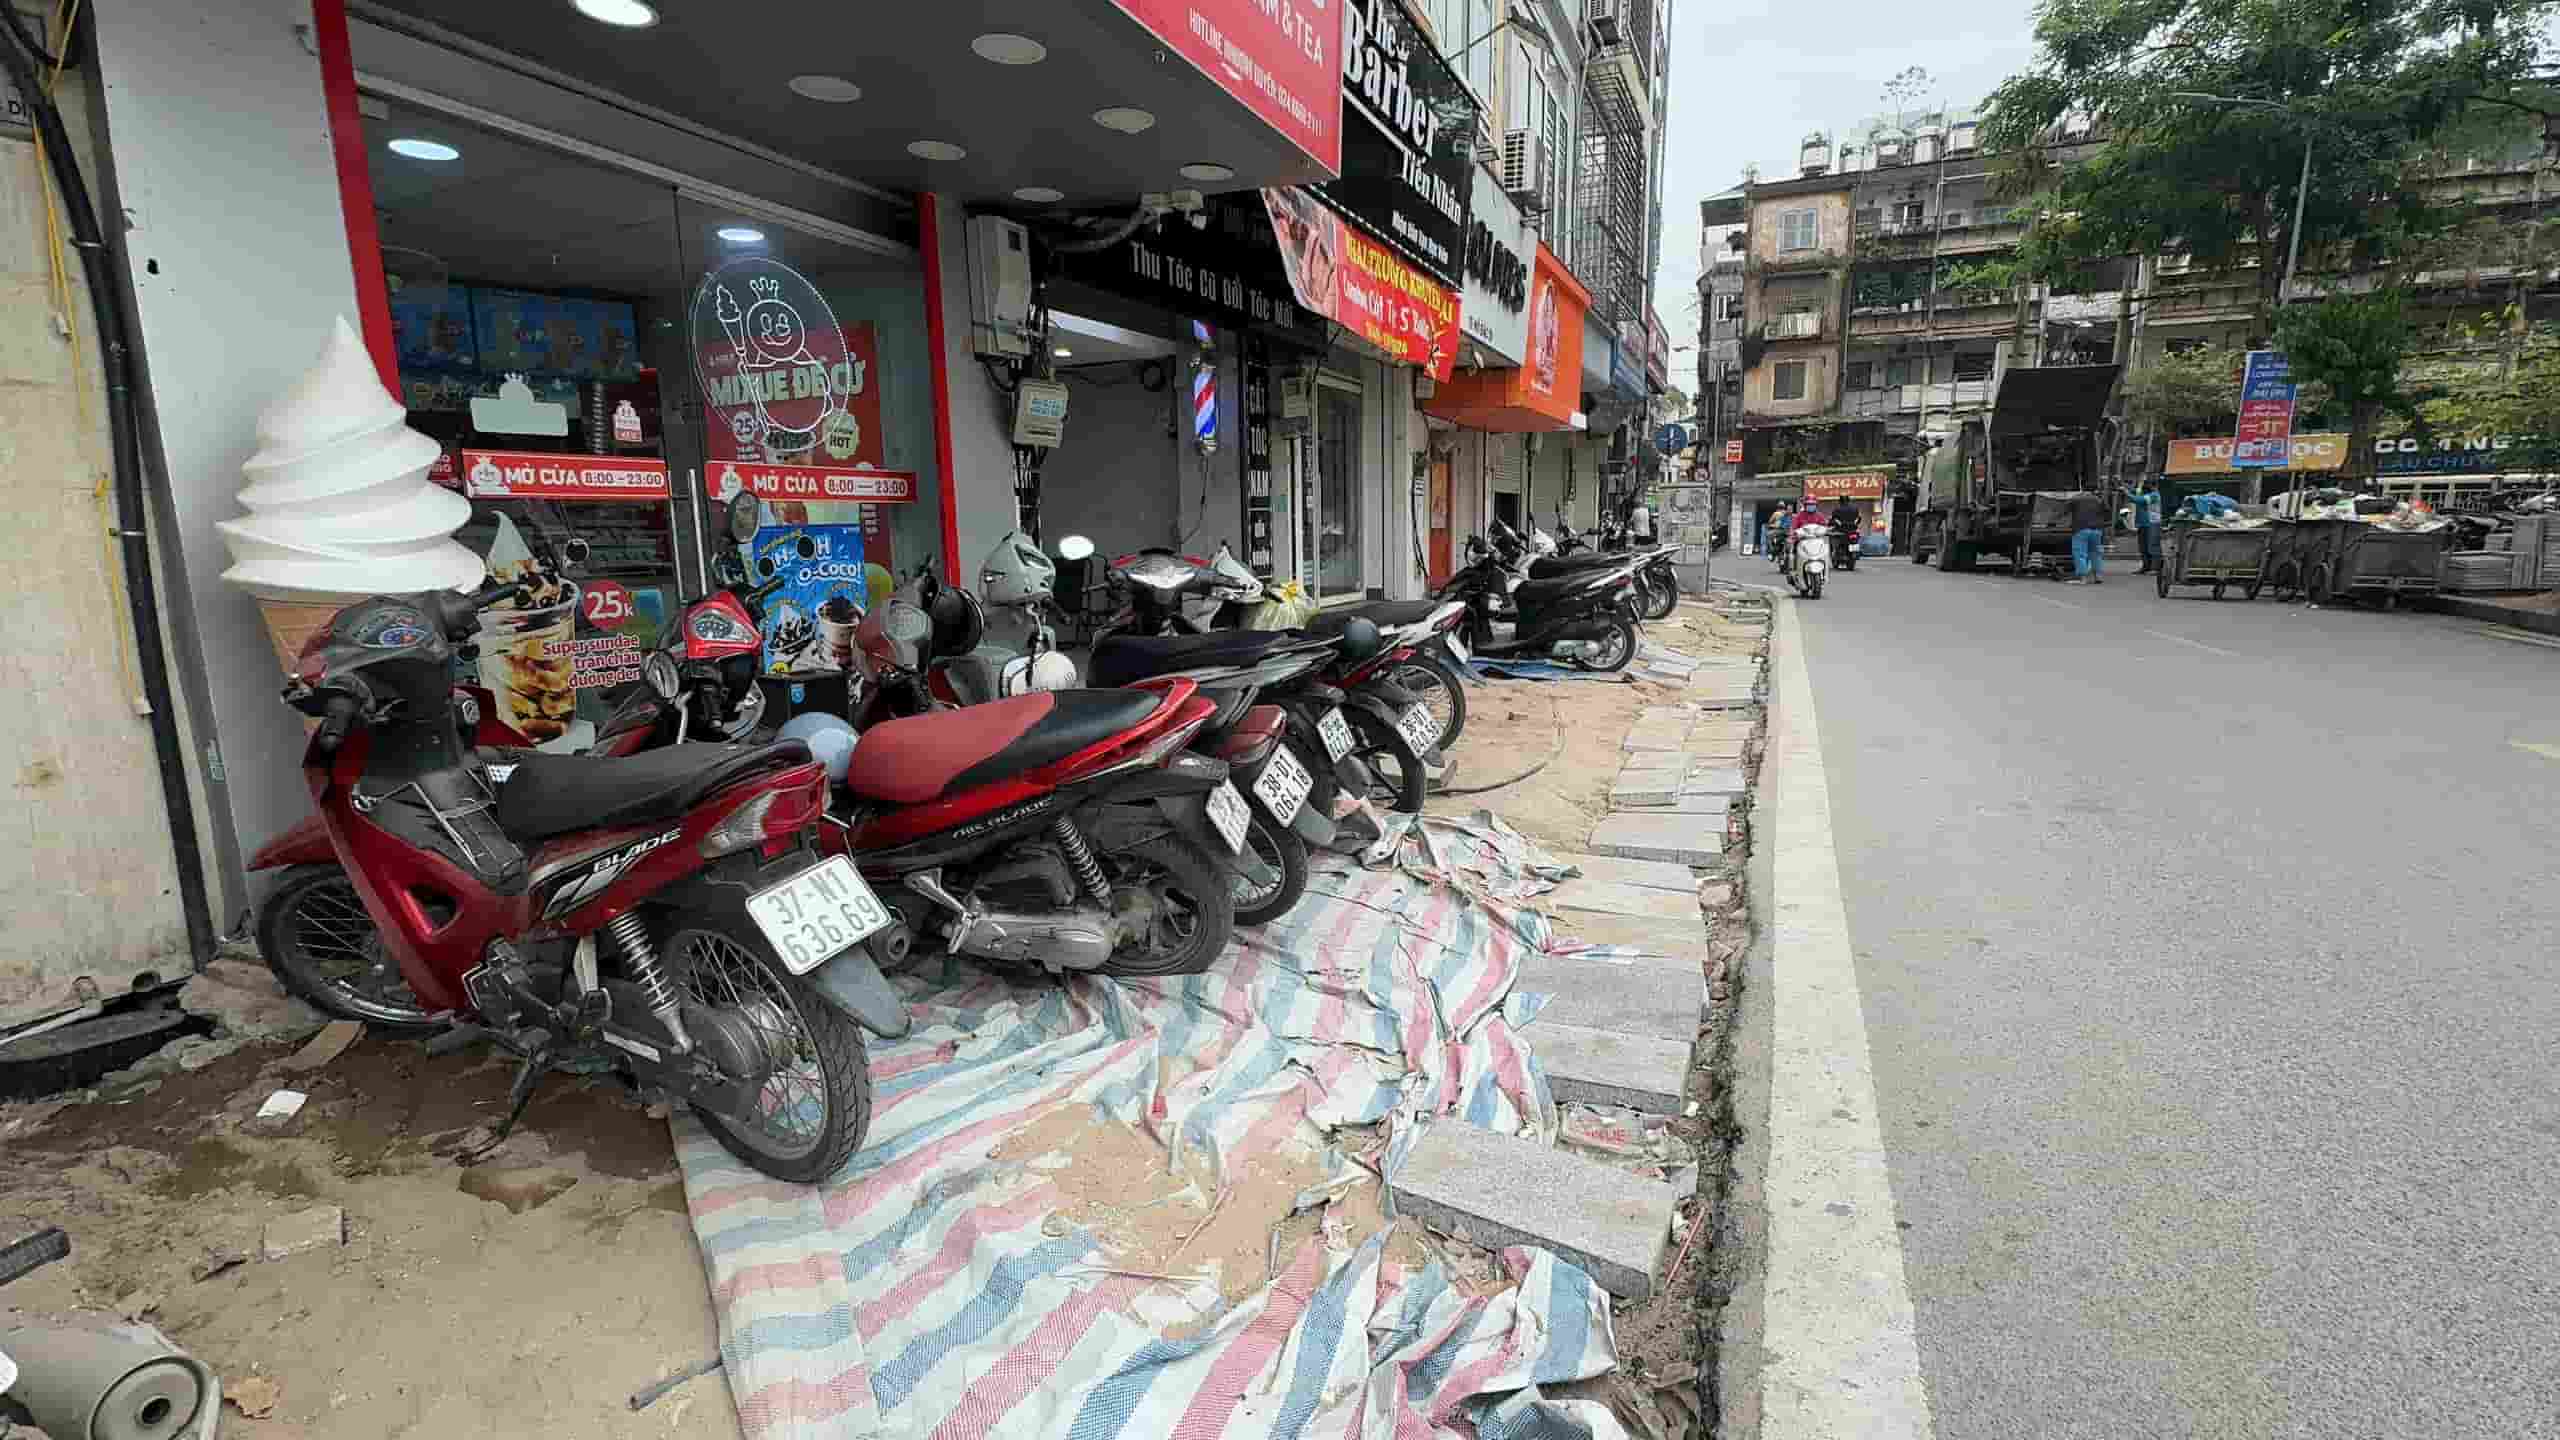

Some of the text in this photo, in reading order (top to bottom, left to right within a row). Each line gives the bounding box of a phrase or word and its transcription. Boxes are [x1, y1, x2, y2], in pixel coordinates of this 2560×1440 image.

[1295, 12, 1324, 68] TEA
[1343, 0, 1439, 158] Barber
[1402, 150, 1432, 204] Tiến
[1166, 255, 1193, 292] Tóc
[709, 369, 788, 407] MIXUE
[504, 461, 536, 485] MỞ
[540, 463, 579, 486] CỬA
[753, 470, 779, 492] MỞ
[784, 471, 819, 494] CỬA
[593, 826, 681, 873] BLADE
[782, 894, 880, 963] 636.69
